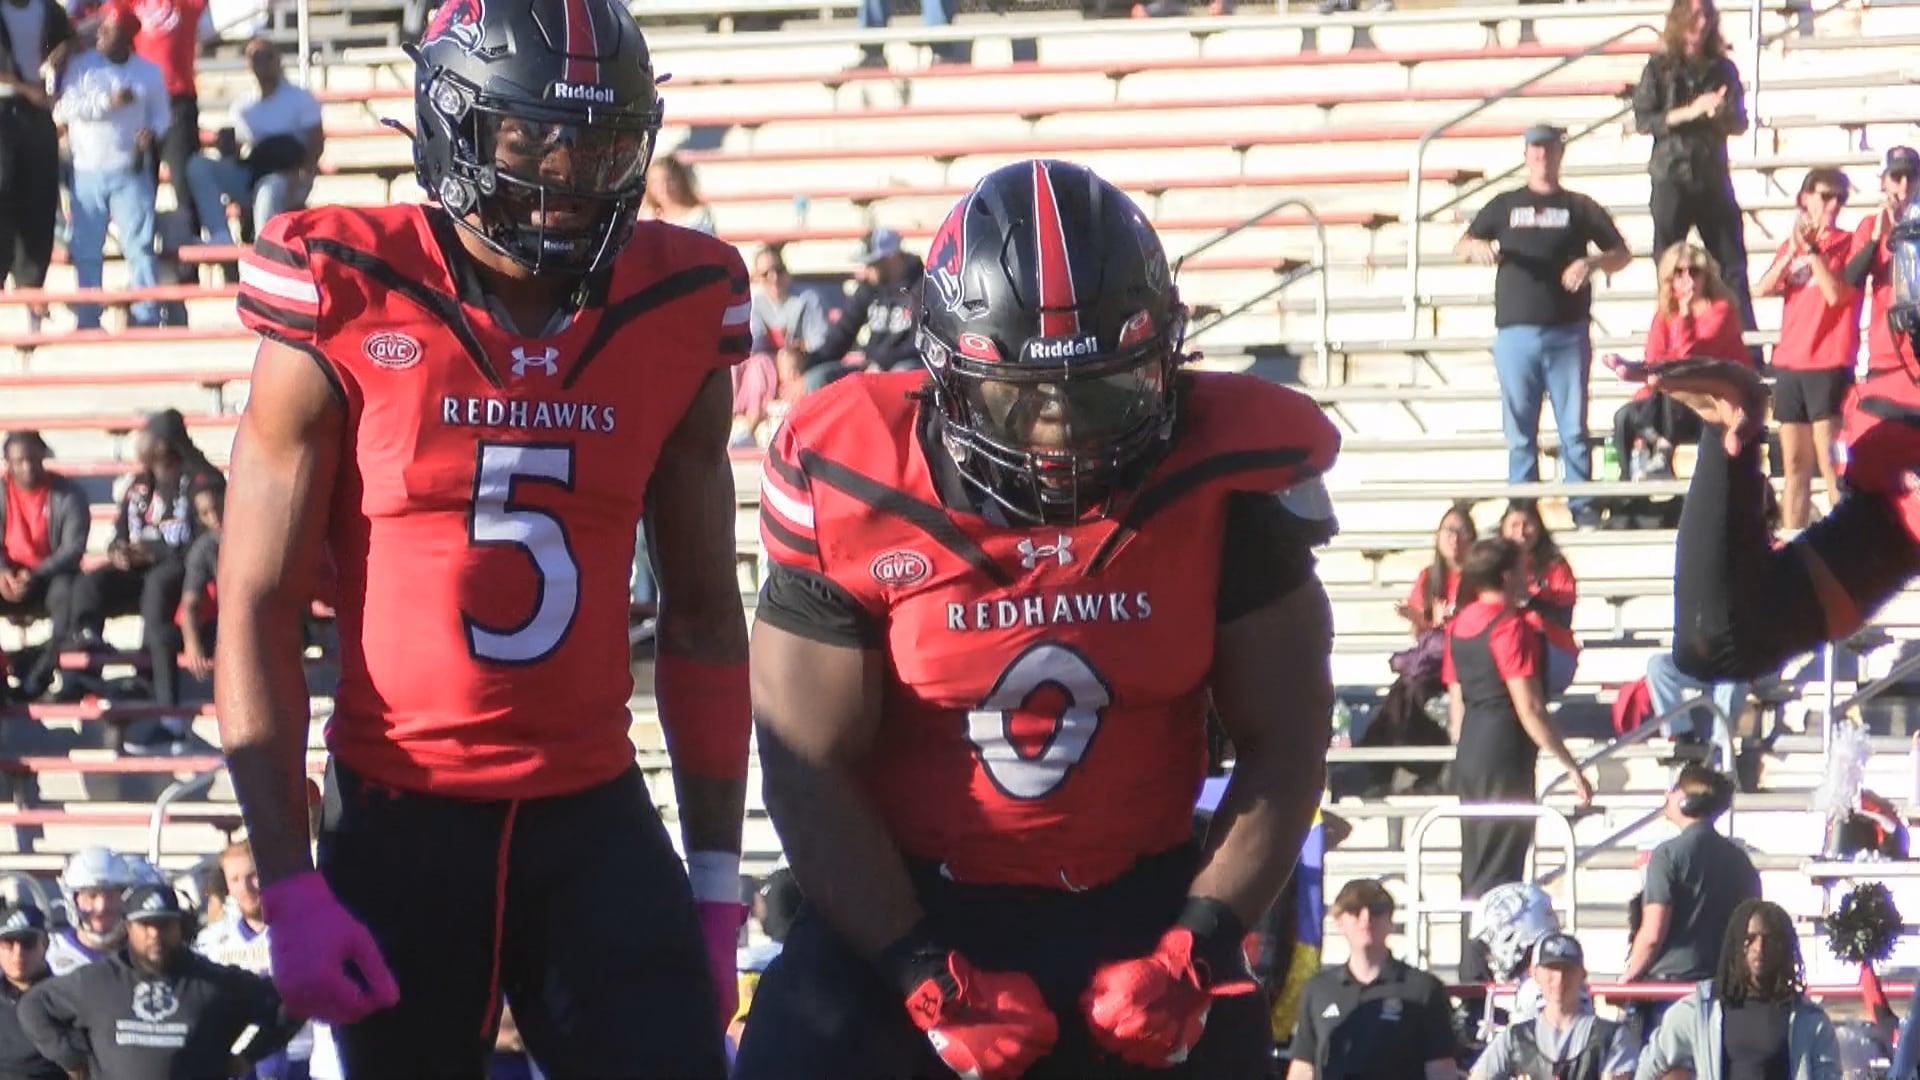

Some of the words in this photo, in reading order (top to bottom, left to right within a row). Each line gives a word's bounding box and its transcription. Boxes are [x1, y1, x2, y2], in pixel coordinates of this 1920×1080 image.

[555, 82, 614, 103] Riddell
[1030, 336, 1098, 358] Riddell
[442, 396, 616, 432] REDHAWKS
[462, 441, 580, 664] 5
[946, 591, 1152, 630] REDHAWKS
